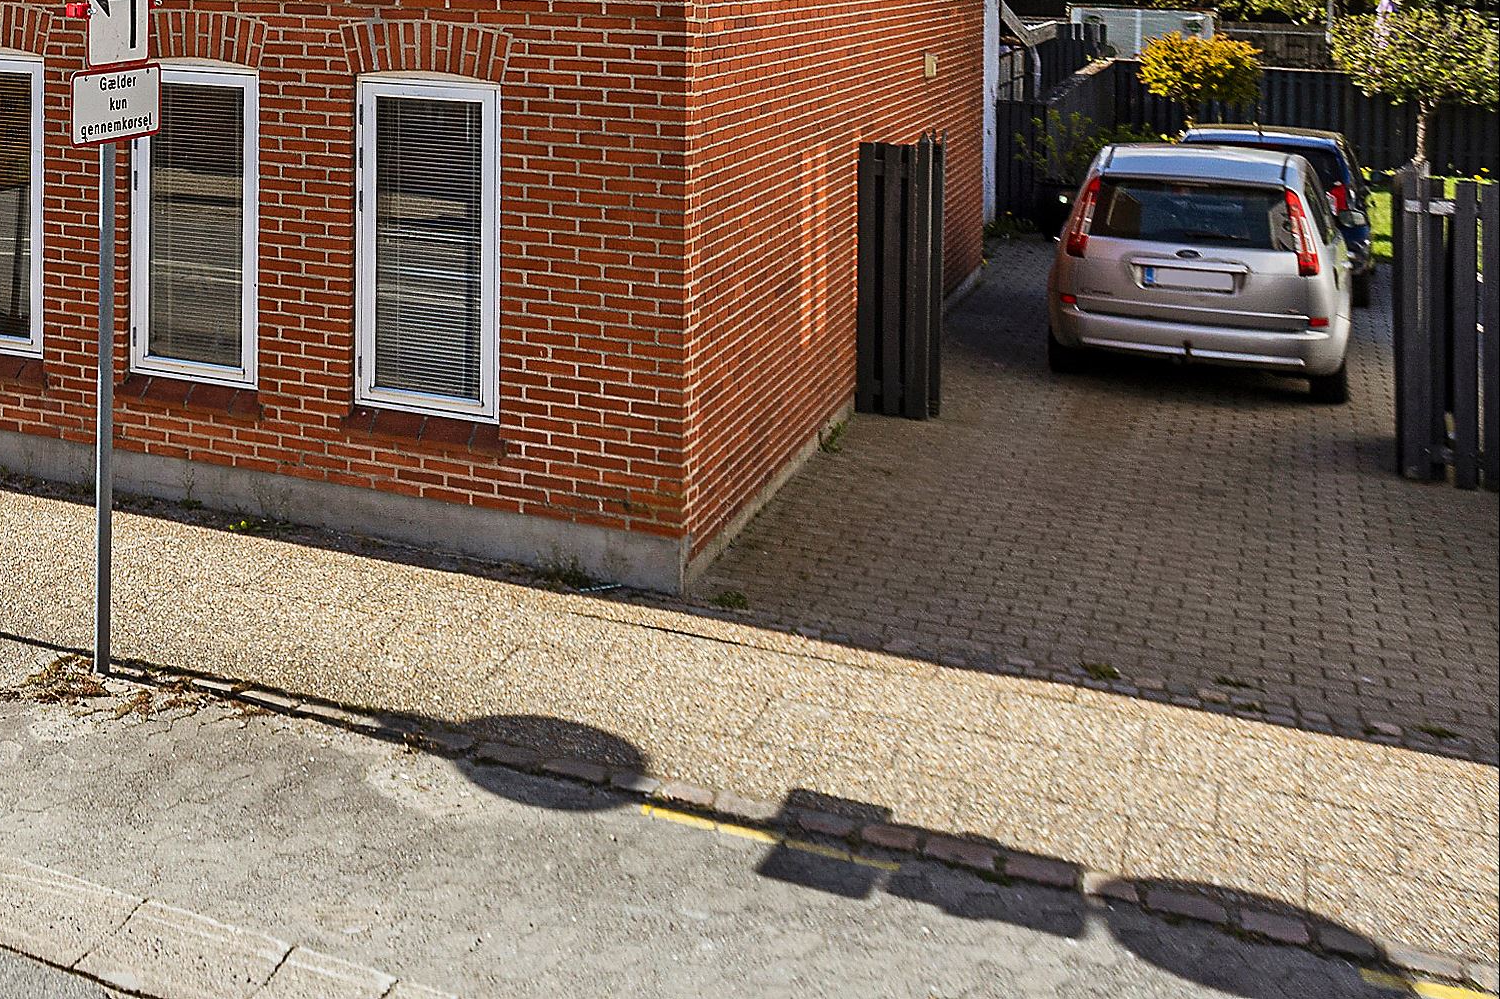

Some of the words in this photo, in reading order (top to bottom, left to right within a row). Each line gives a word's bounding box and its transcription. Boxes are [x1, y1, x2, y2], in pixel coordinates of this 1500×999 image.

[99, 75, 137, 91] Gælder
[109, 97, 128, 111] kun
[80, 112, 153, 139] gennemkørsel
